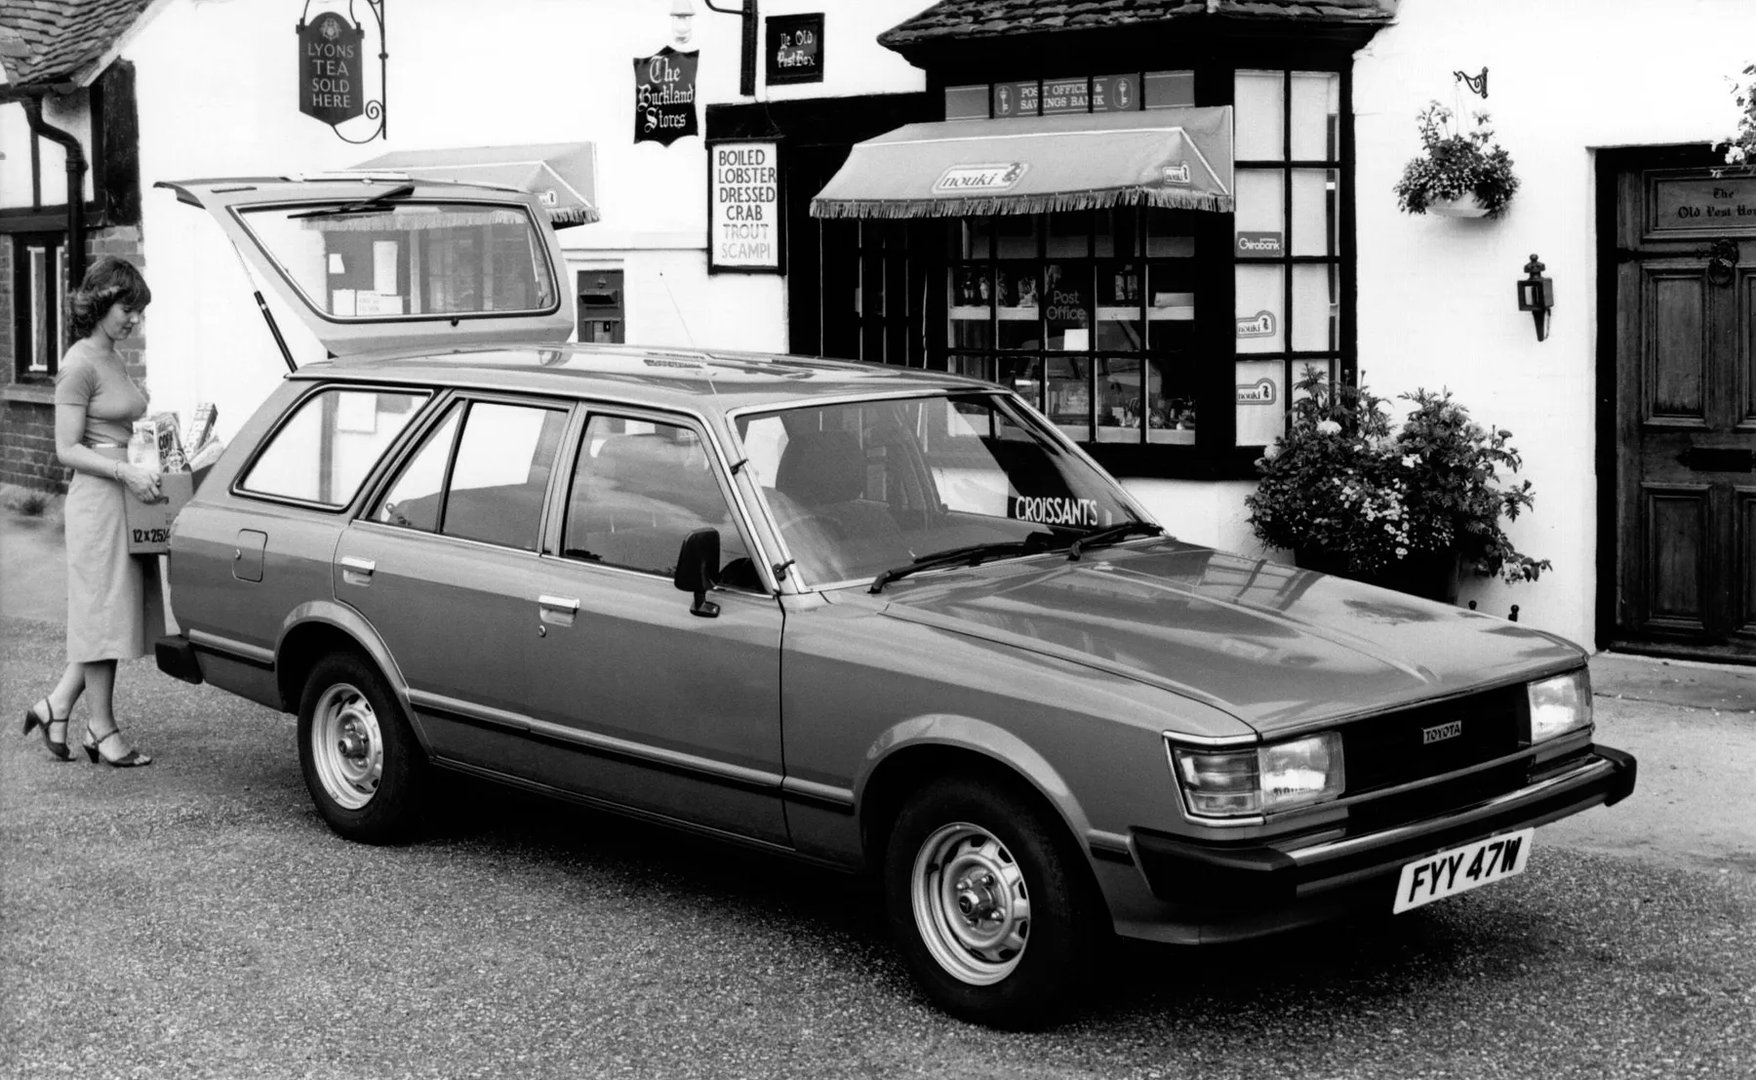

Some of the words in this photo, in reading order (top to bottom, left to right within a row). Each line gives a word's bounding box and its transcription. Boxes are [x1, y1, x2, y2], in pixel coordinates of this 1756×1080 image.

[795, 30, 813, 46] Old
[307, 42, 355, 58] LYONS
[312, 59, 349, 76] TEA
[649, 55, 681, 84] The
[312, 77, 350, 93] SOLD
[1020, 86, 1050, 98] POST
[1052, 83, 1088, 95] OFFICE
[1095, 83, 1103, 92] &
[312, 94, 352, 108] HERE
[637, 83, 694, 113] Buckland
[1020, 97, 1067, 110] SAVINGS
[1070, 95, 1105, 106] BANK
[644, 107, 687, 133] Stores
[719, 149, 765, 166] BOILED
[718, 167, 777, 184] LOBSTER
[942, 173, 998, 187] nouki
[719, 186, 776, 203] DRESSED
[1713, 187, 1734, 200] The
[726, 205, 763, 221] CRAB
[1678, 205, 1701, 219] Old
[1706, 205, 1731, 218] Post
[722, 223, 769, 240] TROUT
[721, 243, 770, 260] SCAMPI
[1239, 237, 1280, 250] Girobank
[1053, 290, 1080, 305] Post
[1046, 305, 1087, 321] Office
[132, 528, 143, 543] 12
[1424, 723, 1462, 743] TOYOTA
[1408, 853, 1465, 903] FYY
[1466, 836, 1523, 881] 47W
